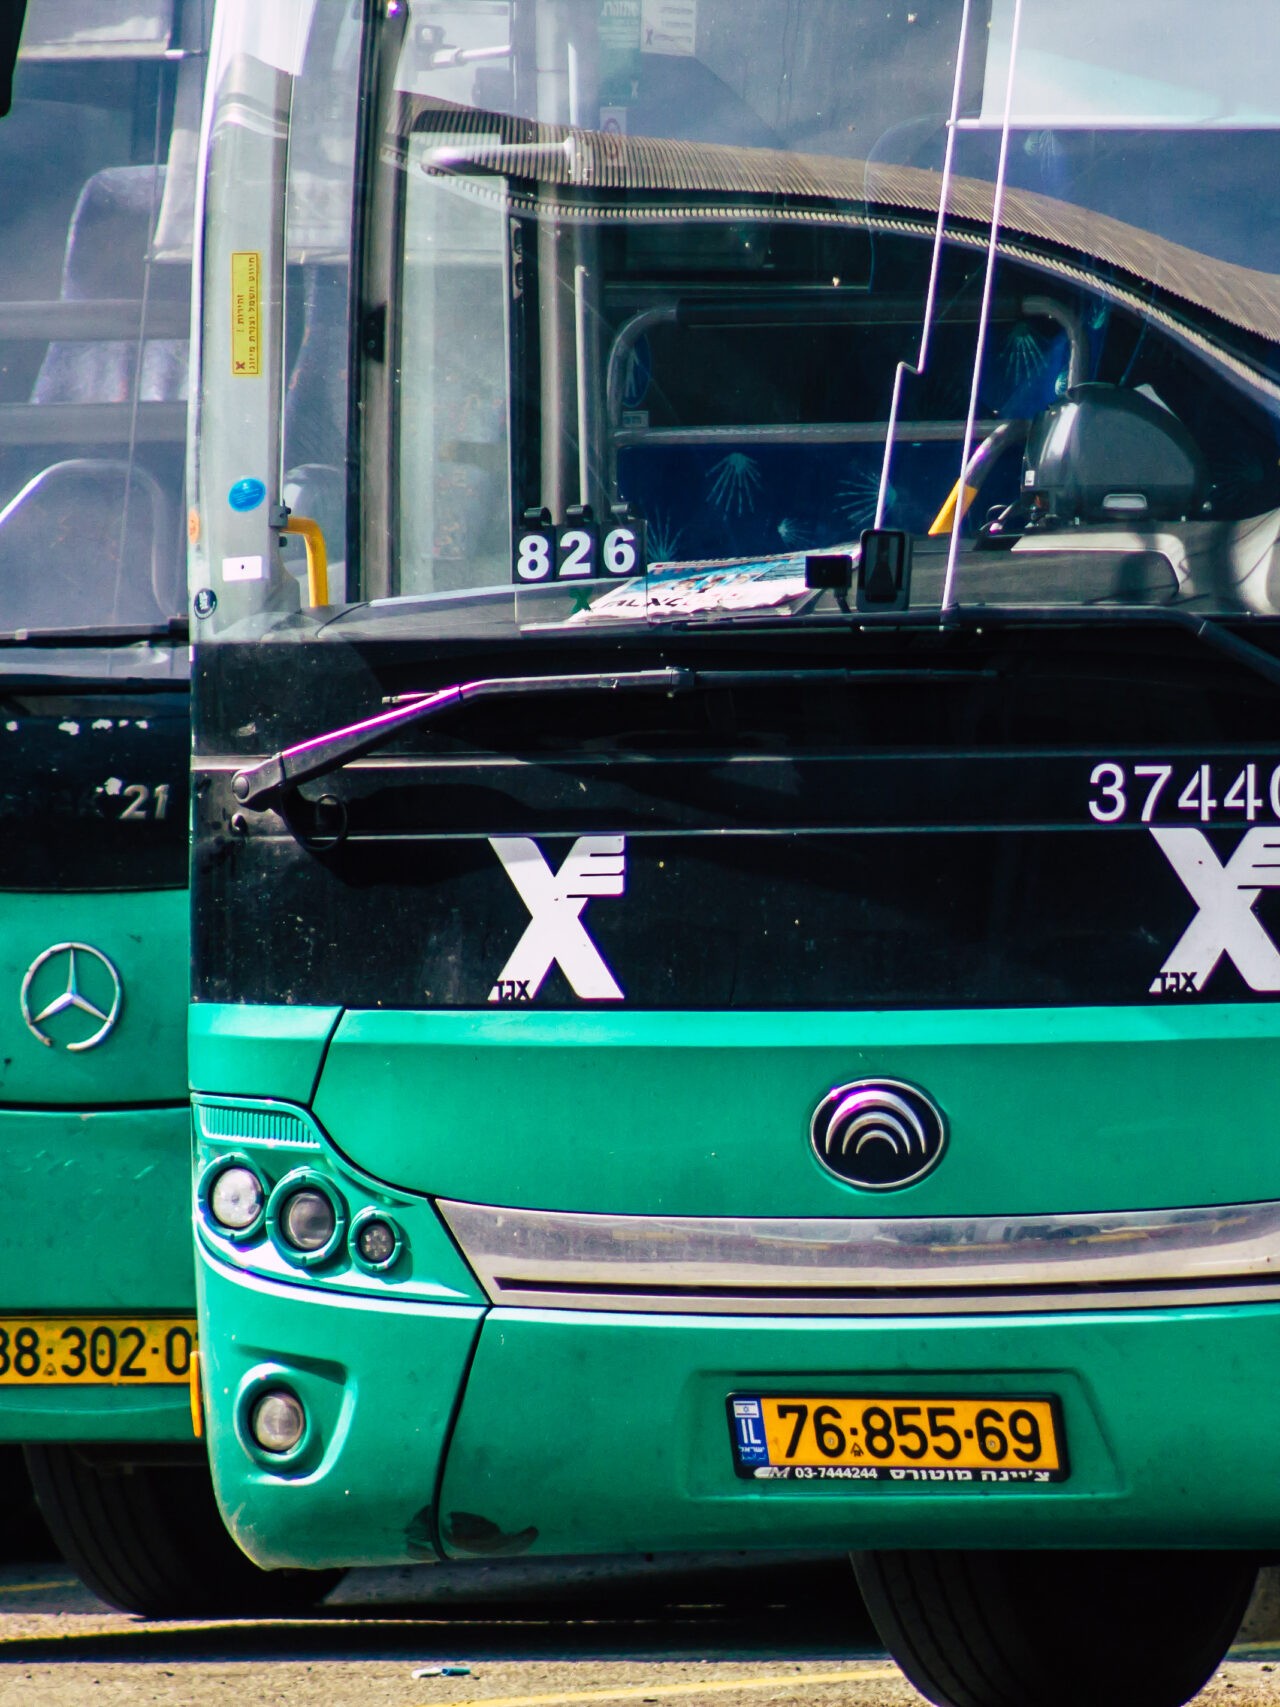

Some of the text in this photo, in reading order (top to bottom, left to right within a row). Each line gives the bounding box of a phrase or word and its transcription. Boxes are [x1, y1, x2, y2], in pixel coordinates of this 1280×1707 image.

[516, 528, 636, 580] 826
[741, 1419, 762, 1444] IL
[795, 1467, 878, 1479] 03-7444244
